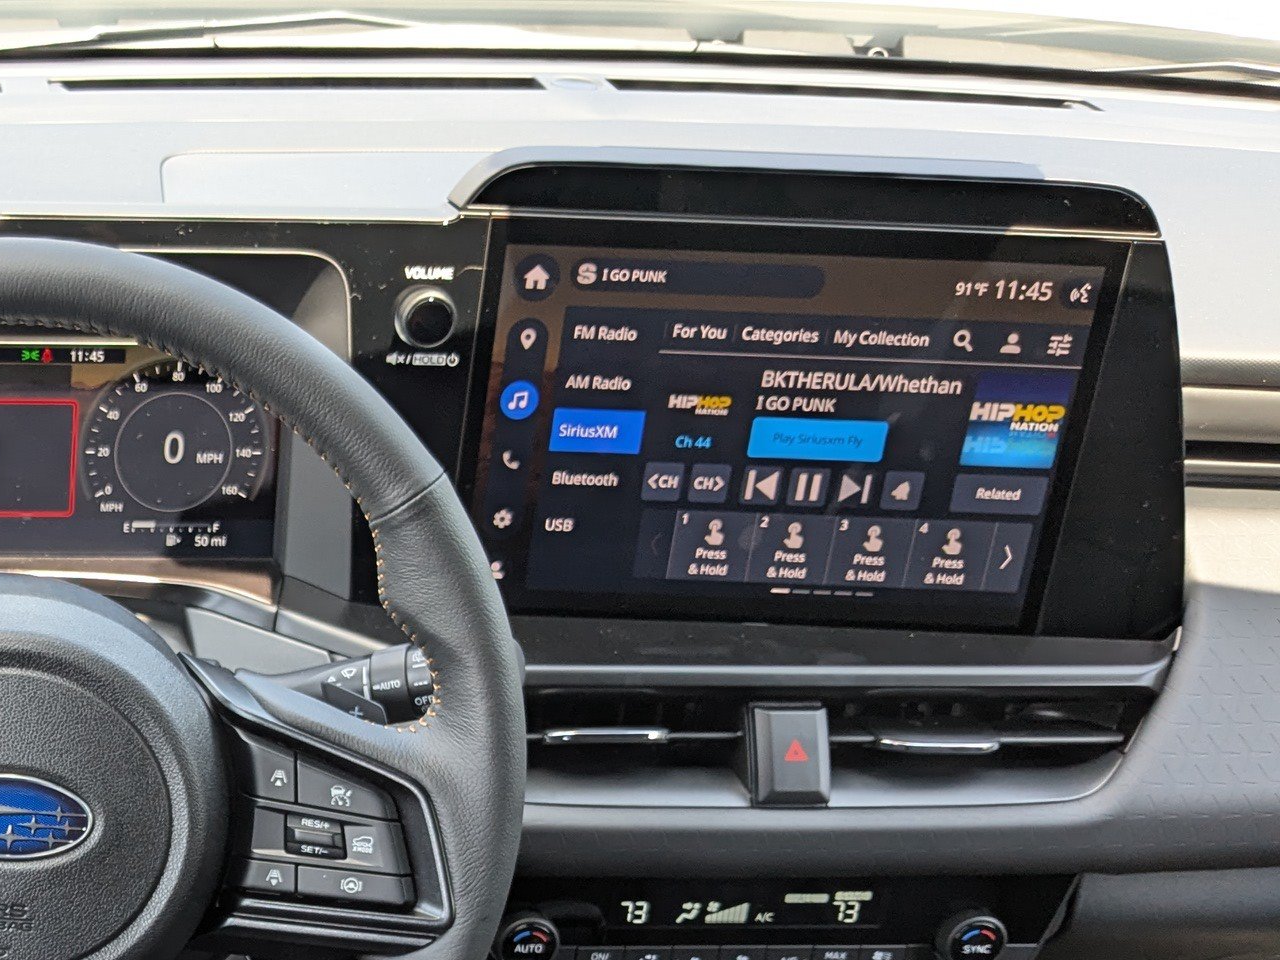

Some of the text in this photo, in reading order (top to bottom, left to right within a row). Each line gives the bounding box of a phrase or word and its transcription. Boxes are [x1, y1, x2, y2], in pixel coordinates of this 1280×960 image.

[404, 265, 456, 280] VOLUME
[610, 269, 630, 283] GO
[631, 269, 668, 284] PUNK
[995, 278, 1054, 302] 11:45
[573, 325, 638, 342] FM Radio
[672, 323, 728, 340] For You
[741, 325, 820, 345] Categories
[833, 328, 931, 348] My Collection
[69, 350, 106, 363] 11:45
[413, 355, 445, 364] HOLD
[171, 371, 186, 382] 80
[565, 374, 632, 391] AM Radio
[760, 369, 963, 396] BKTHERULA/Whethan
[134, 382, 148, 393] 60
[205, 382, 223, 394] 100
[765, 396, 791, 412] GO
[792, 396, 837, 413] PUNK
[106, 409, 121, 421] 40
[228, 411, 247, 423] 120
[558, 423, 619, 440] SiriusXM
[1009, 422, 1060, 432] NATION
[675, 434, 712, 449] Ch 44
[773, 432, 795, 446] Play
[847, 434, 863, 448] Fly
[97, 446, 110, 458] 20
[163, 430, 224, 465] 0 MPH
[235, 448, 252, 459] 140
[551, 470, 620, 487] Bluetooth
[104, 484, 113, 495] 0
[221, 485, 238, 496] 160
[974, 487, 1022, 501] Related
[100, 502, 124, 513] MPH
[544, 517, 575, 532] USB
[681, 513, 690, 525] 1
[759, 515, 770, 528] 2
[838, 518, 850, 531] 3
[123, 522, 131, 533] E
[212, 522, 220, 533] F
[919, 522, 929, 534] 4
[194, 535, 228, 548] 50 mi
[694, 547, 727, 560] Press
[774, 550, 806, 564] Press
[852, 553, 885, 566] Press
[687, 563, 729, 576] & Hold
[931, 556, 964, 570] Press
[766, 566, 808, 579] & Hold
[844, 569, 886, 583] & Hold
[923, 573, 965, 586] & Hold
[379, 679, 401, 691] AUTO
[621, 900, 650, 924] 73
[754, 912, 775, 923] A/C
[832, 900, 860, 923] 73
[514, 943, 543, 954] AUTO
[961, 943, 992, 955] SYNC
[824, 951, 847, 960] MAX
